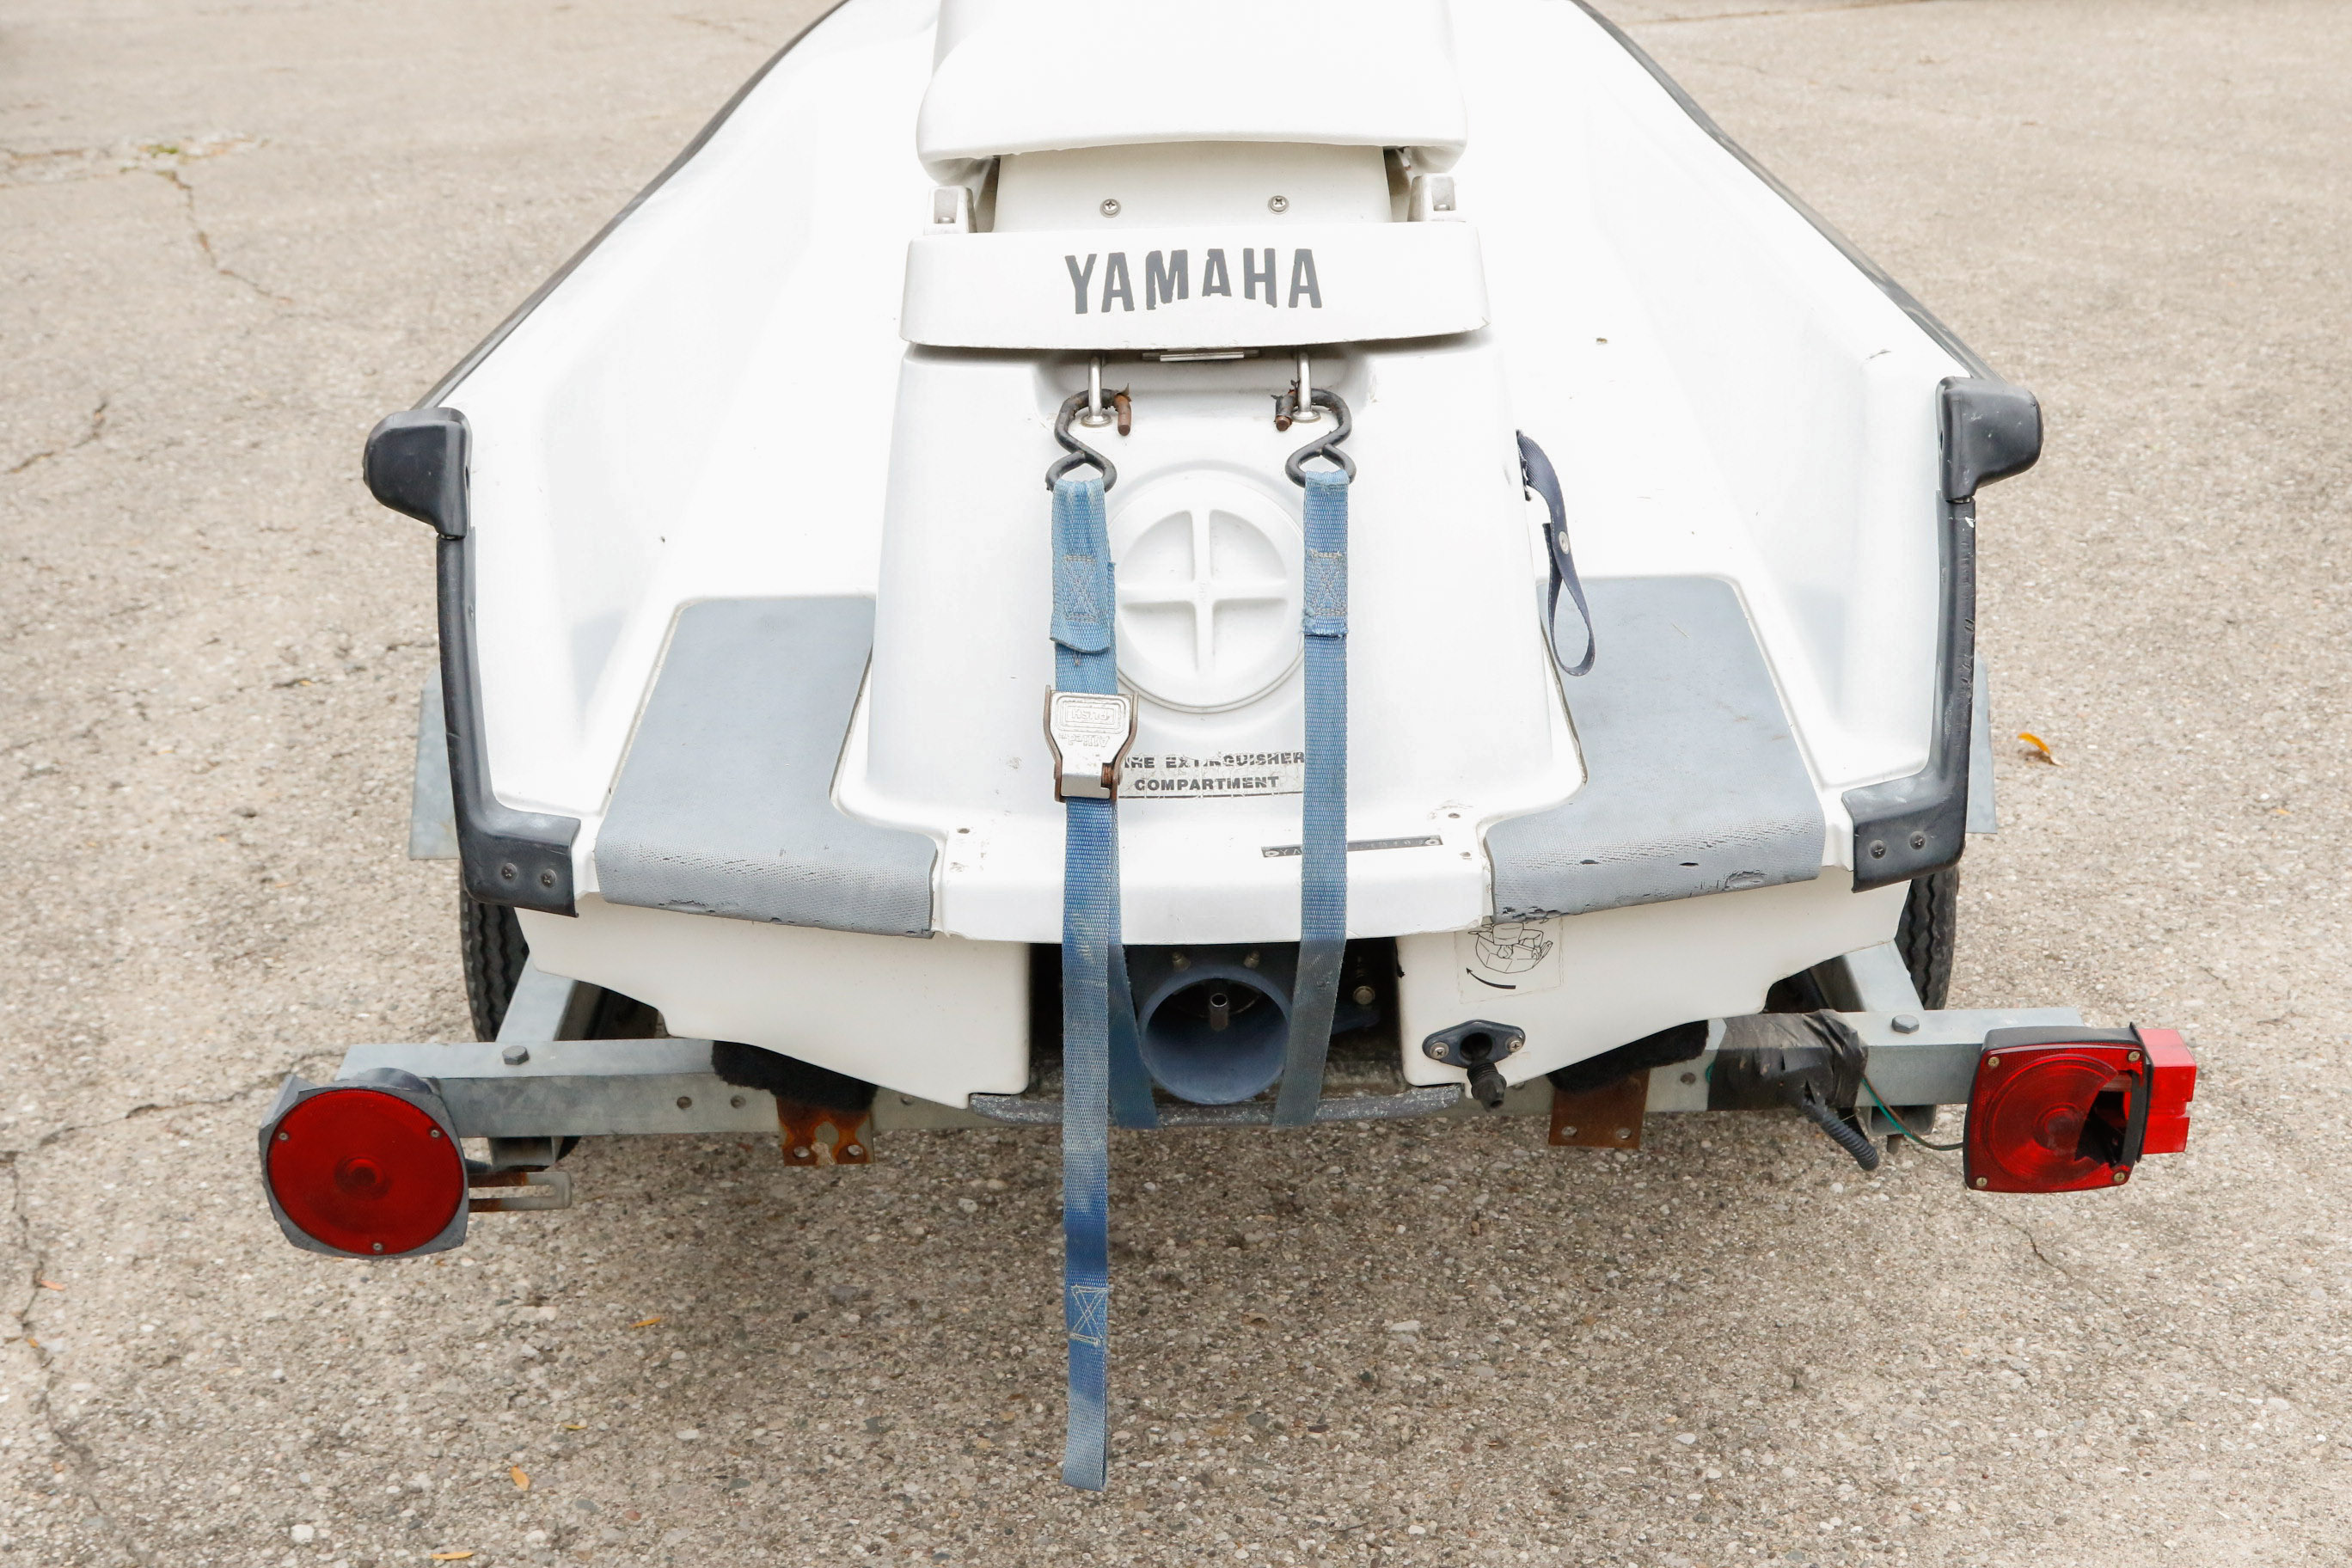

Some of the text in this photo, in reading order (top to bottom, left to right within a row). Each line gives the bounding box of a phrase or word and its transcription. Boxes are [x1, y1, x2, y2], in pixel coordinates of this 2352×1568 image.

[1063, 247, 1323, 315] YAMAHA
[1124, 756, 1155, 769] IRE
[1134, 775, 1279, 791] COMPARTMENT
